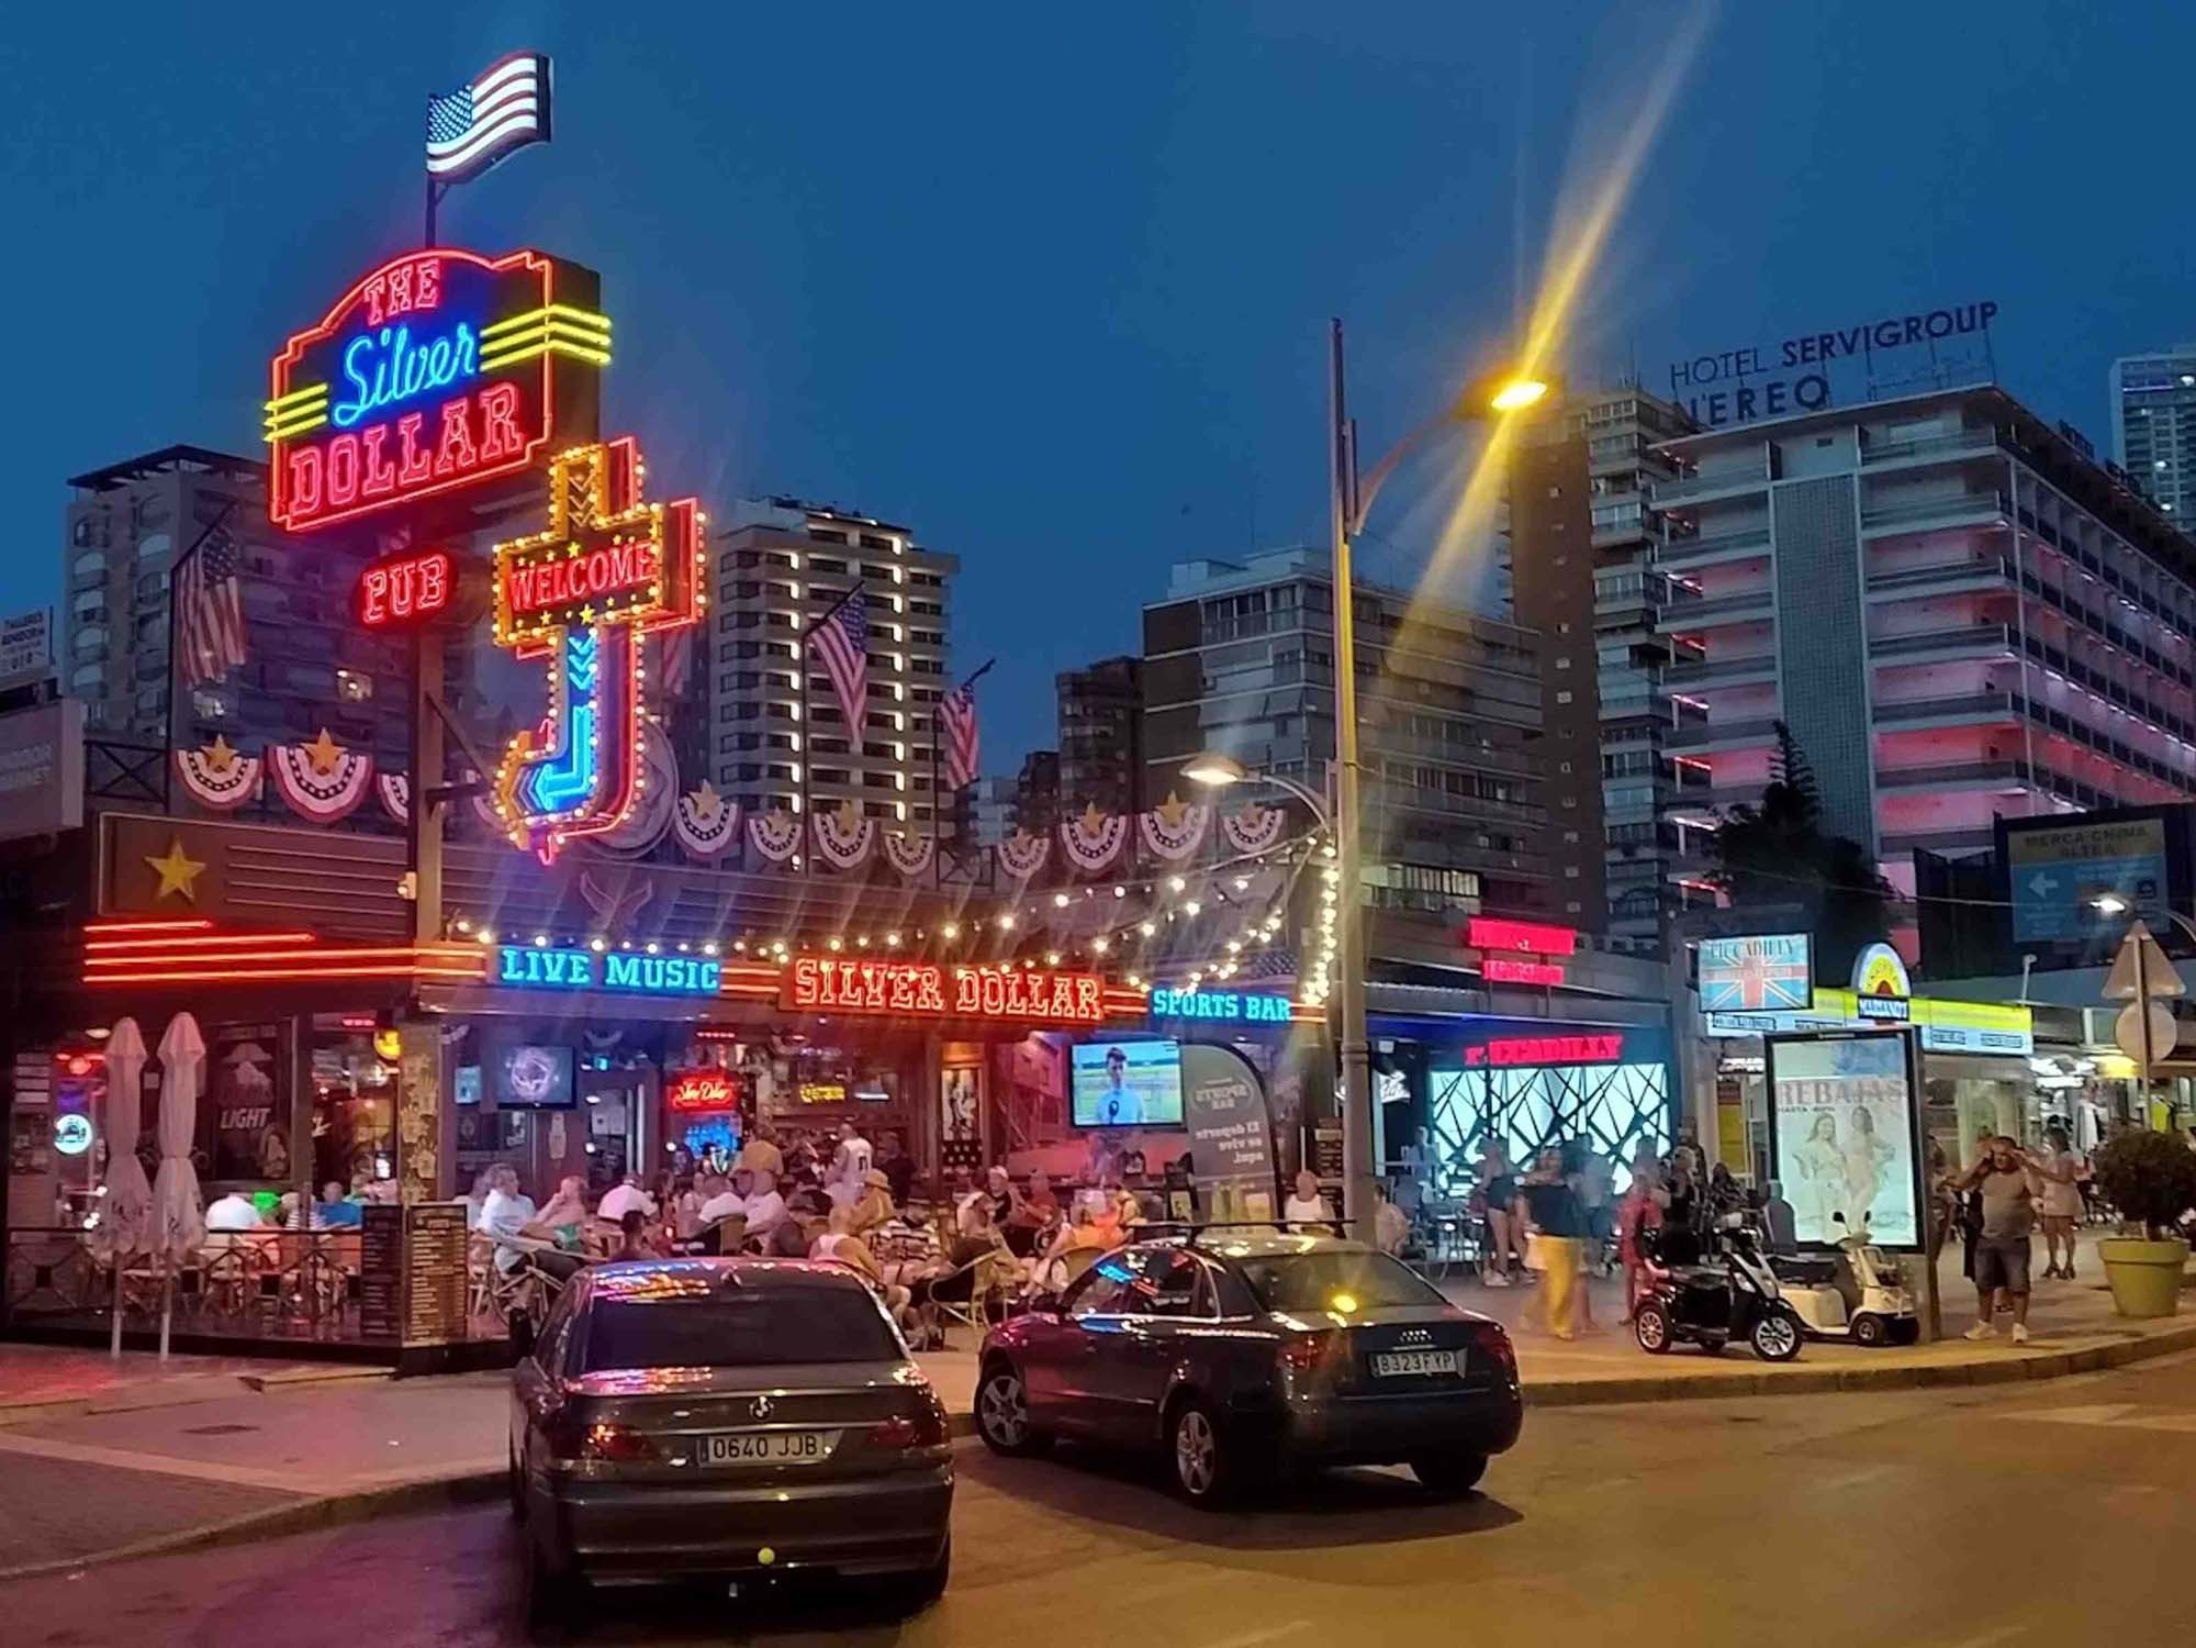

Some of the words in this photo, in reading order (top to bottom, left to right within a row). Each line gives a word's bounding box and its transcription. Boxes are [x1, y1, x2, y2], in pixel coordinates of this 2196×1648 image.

[363, 258, 441, 326] THE
[333, 322, 475, 428] Silver
[1670, 347, 1768, 388] HOTEL
[1781, 301, 1998, 368] SERVIGROUP
[289, 380, 530, 517] DOLLAR
[362, 553, 450, 624] PUB
[511, 540, 657, 612] WELCOME
[501, 949, 592, 984] LIVE
[605, 954, 719, 990] MUSIC
[795, 957, 944, 1012] SILVER
[956, 966, 1105, 1021] DOLLAR
[1152, 988, 1239, 1019] SPORTS
[1245, 995, 1293, 1022] BAR
[220, 1107, 272, 1130] LIGHT
[1777, 1079, 1906, 1105] REBAJAS
[713, 1437, 768, 1459] 0640
[777, 1434, 818, 1457] JJB
